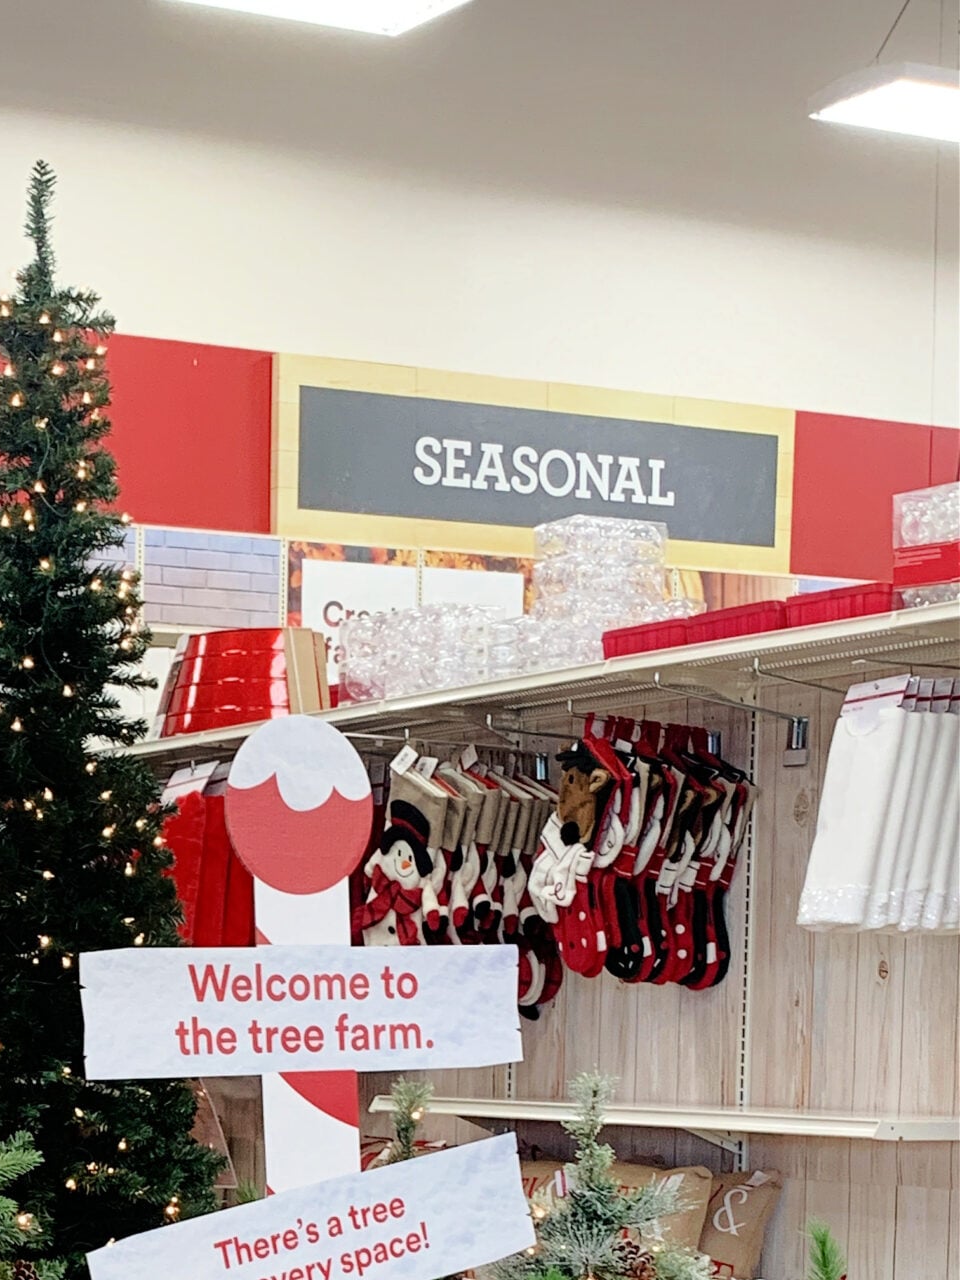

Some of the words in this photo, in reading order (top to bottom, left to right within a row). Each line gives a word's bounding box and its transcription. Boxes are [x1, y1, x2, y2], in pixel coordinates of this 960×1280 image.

[413, 436, 675, 506] SEASONAL
[187, 963, 370, 1003] Welcome
[380, 965, 419, 1000] to
[175, 1016, 237, 1056] the
[248, 1019, 325, 1054] tree
[335, 1013, 435, 1052] farm.
[214, 1218, 321, 1270] There's
[327, 1213, 344, 1237] a
[348, 1197, 406, 1231] tree
[340, 1222, 431, 1276] space!
